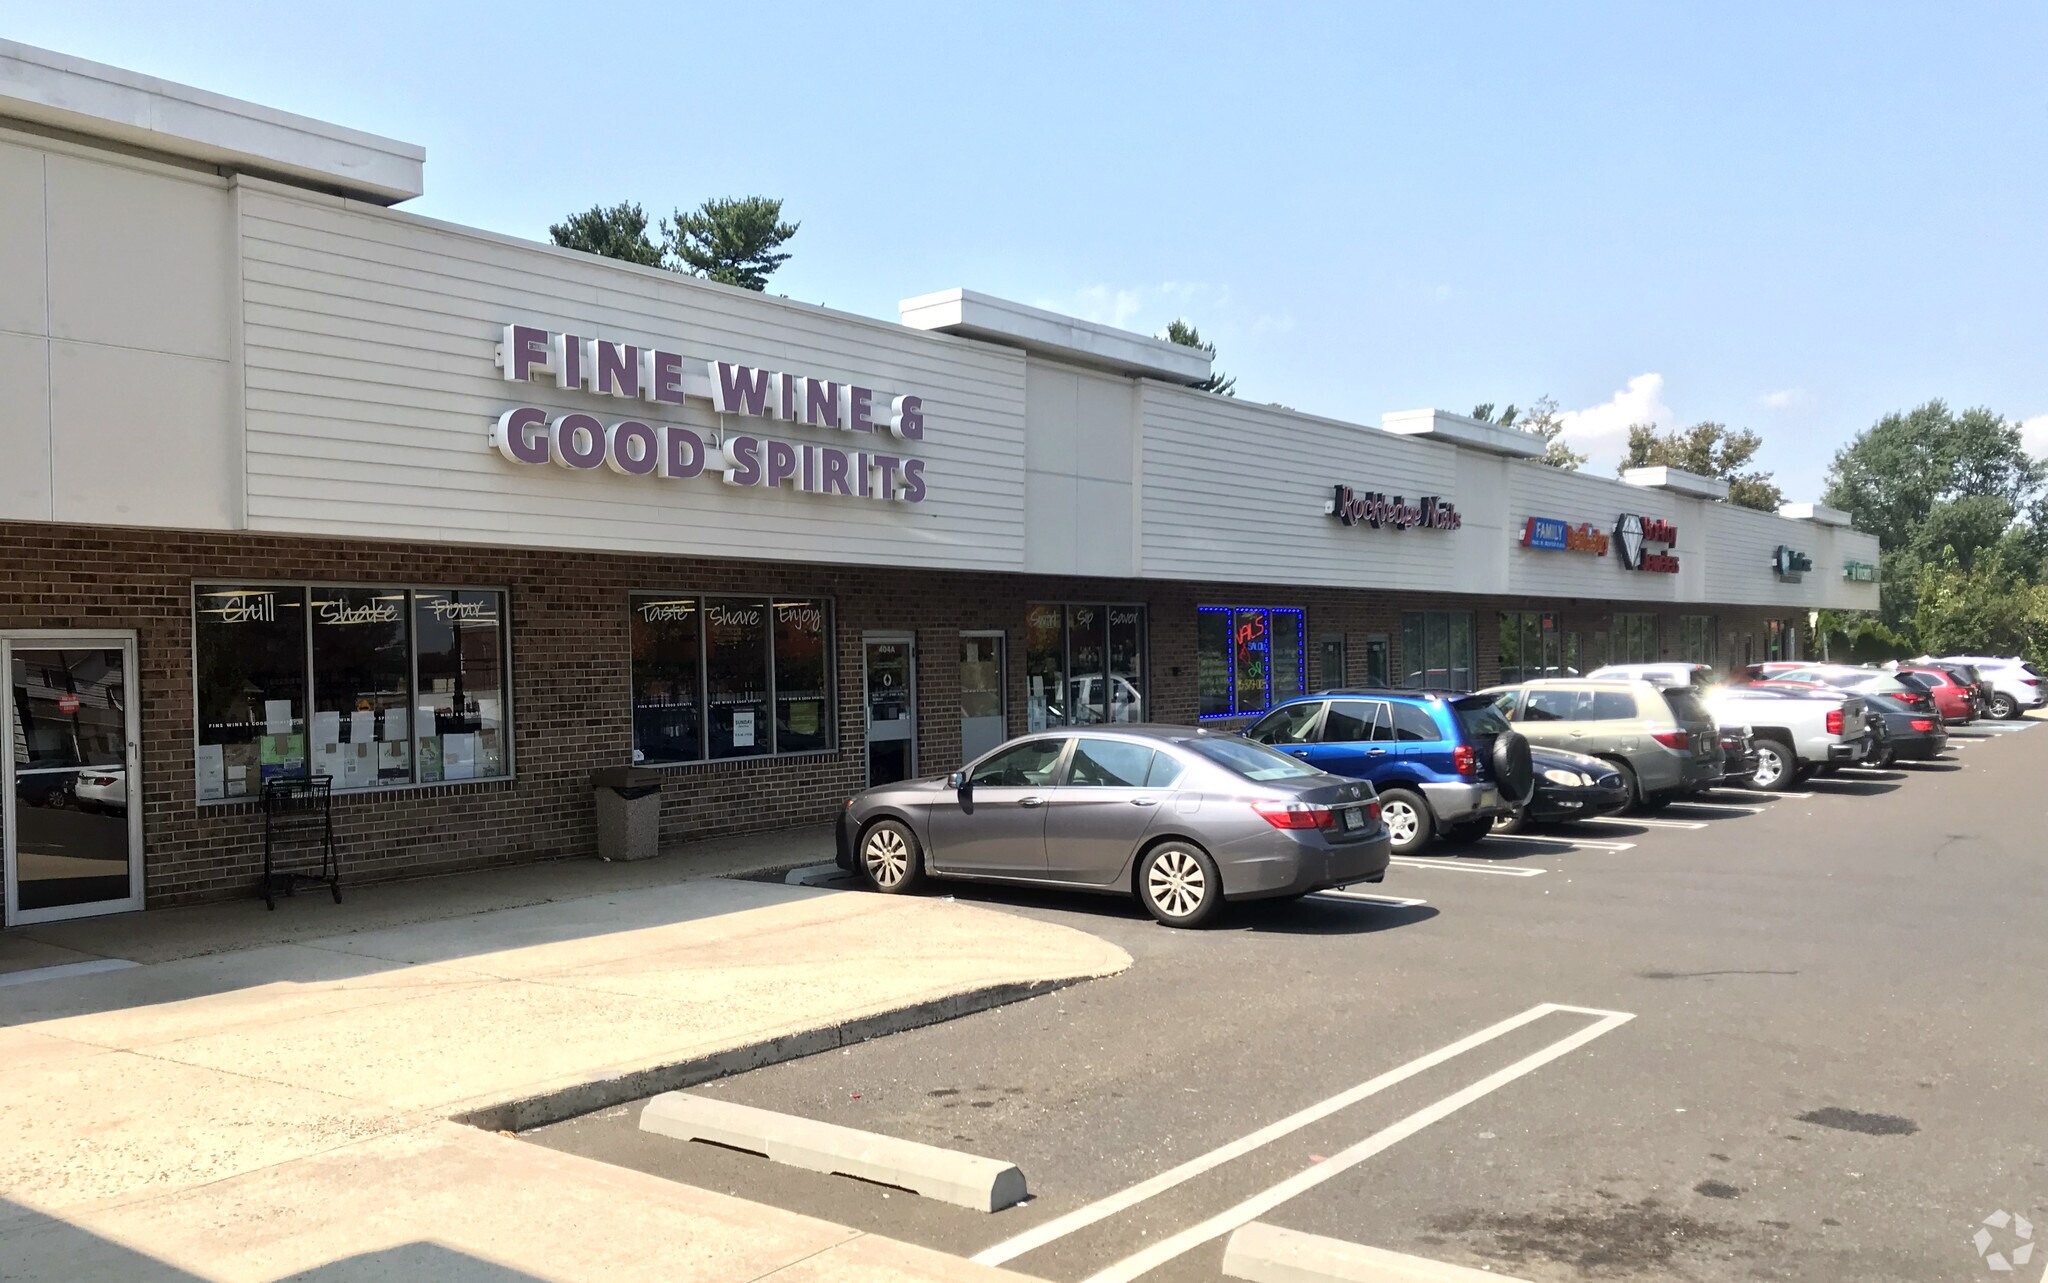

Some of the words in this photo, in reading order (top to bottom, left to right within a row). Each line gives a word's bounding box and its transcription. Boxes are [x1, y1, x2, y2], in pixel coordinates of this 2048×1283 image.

[503, 324, 685, 405] FINE
[708, 360, 874, 433] WINE
[892, 395, 924, 440] &
[498, 407, 706, 479] GOOD
[723, 435, 926, 503] SPIRITS
[1334, 485, 1420, 529] Rockledge
[1421, 496, 1461, 529] Nails
[1535, 521, 1564, 541] FAMILY
[223, 594, 275, 622] Chill
[320, 598, 398, 624] Shake
[431, 599, 484, 621] Pour
[637, 603, 688, 622] Taste
[709, 605, 760, 626] Share
[778, 606, 822, 631] Enjoy
[1110, 610, 1139, 626] Savor
[1077, 610, 1094, 631] Sip
[879, 645, 896, 654] 404A
